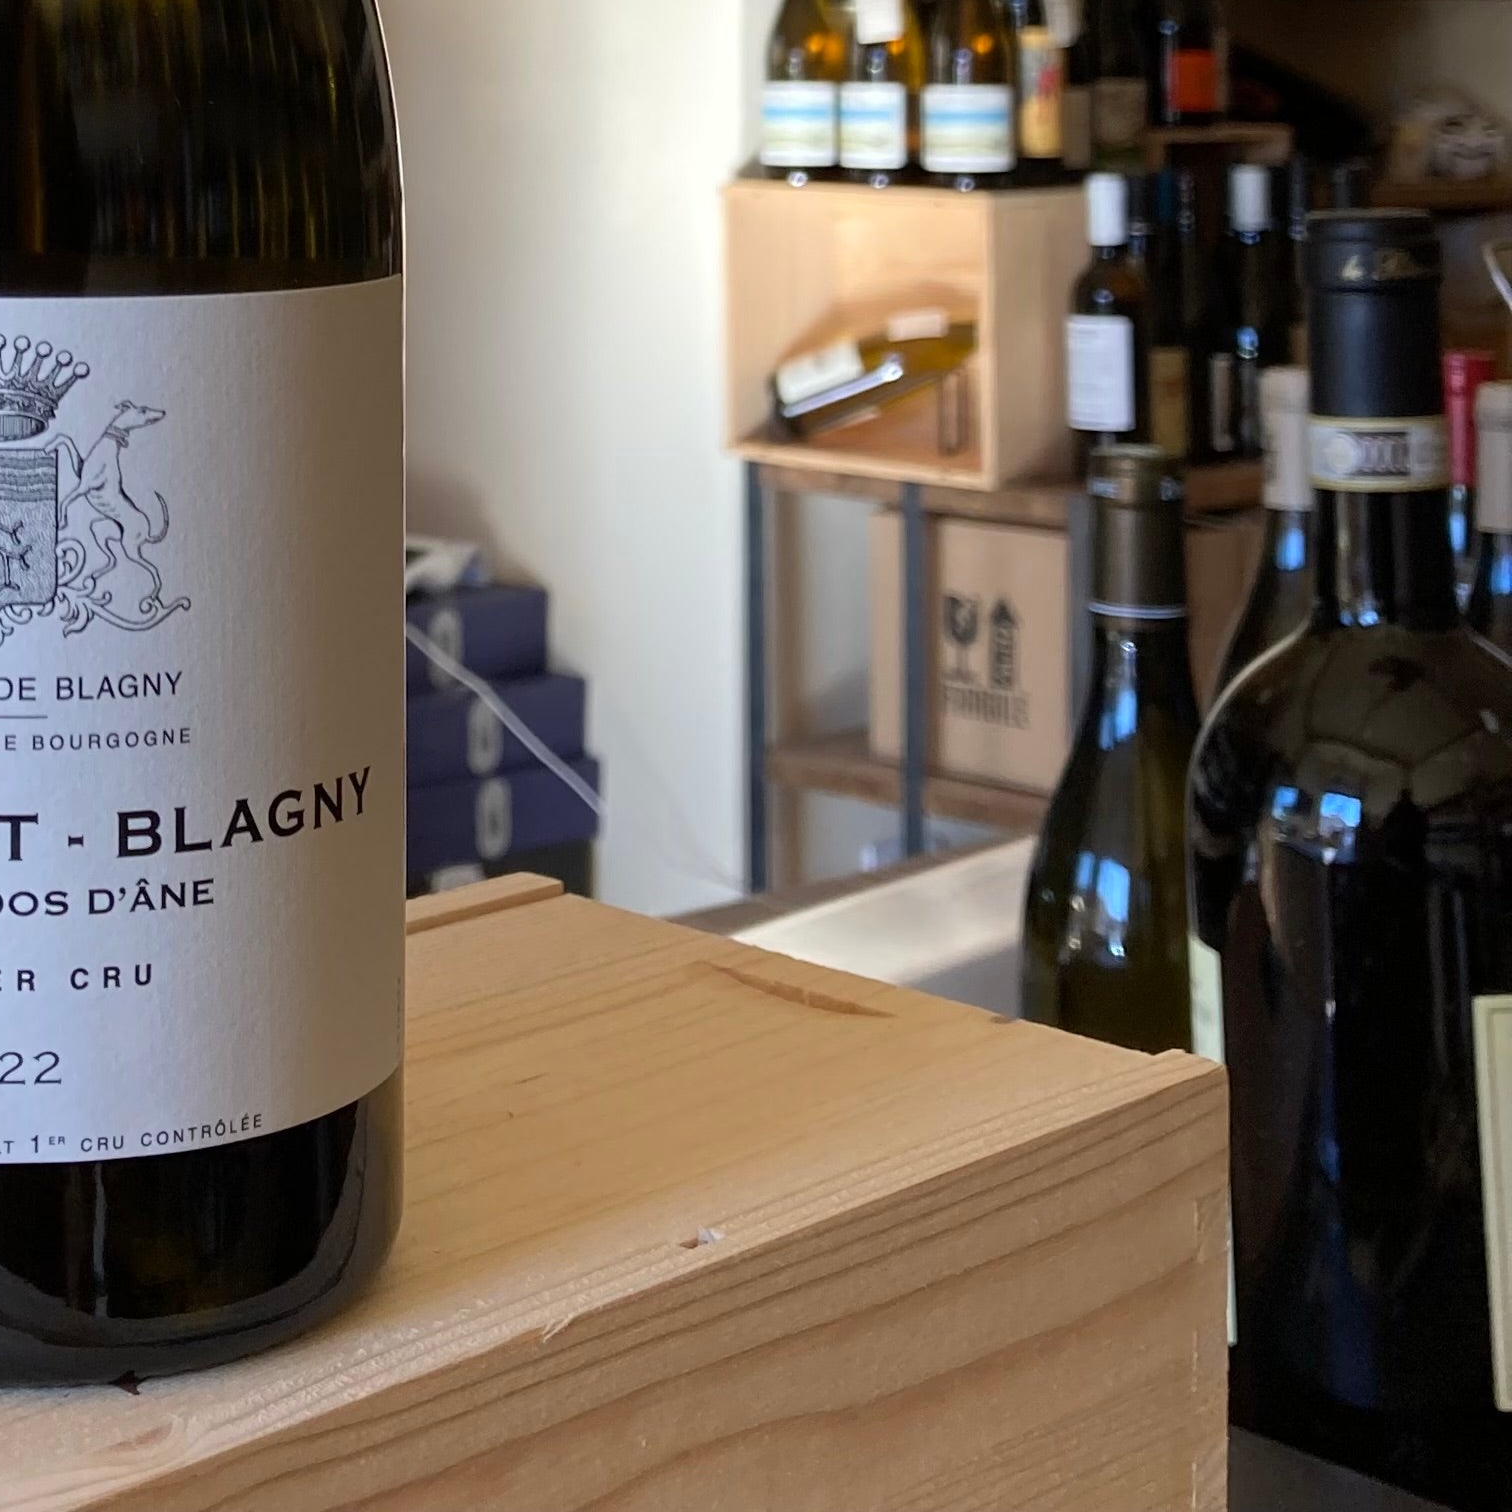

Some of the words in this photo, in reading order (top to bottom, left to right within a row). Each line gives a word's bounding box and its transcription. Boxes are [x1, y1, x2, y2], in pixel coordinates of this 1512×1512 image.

[55, 670, 183, 702] BLAGNY
[31, 727, 191, 752] BOURGOGNE
[115, 765, 372, 860] BLAGNY
[69, 962, 153, 991] CRU
[79, 1134, 125, 1153] CRU
[140, 1112, 262, 1148] CONTRÔLÉE
